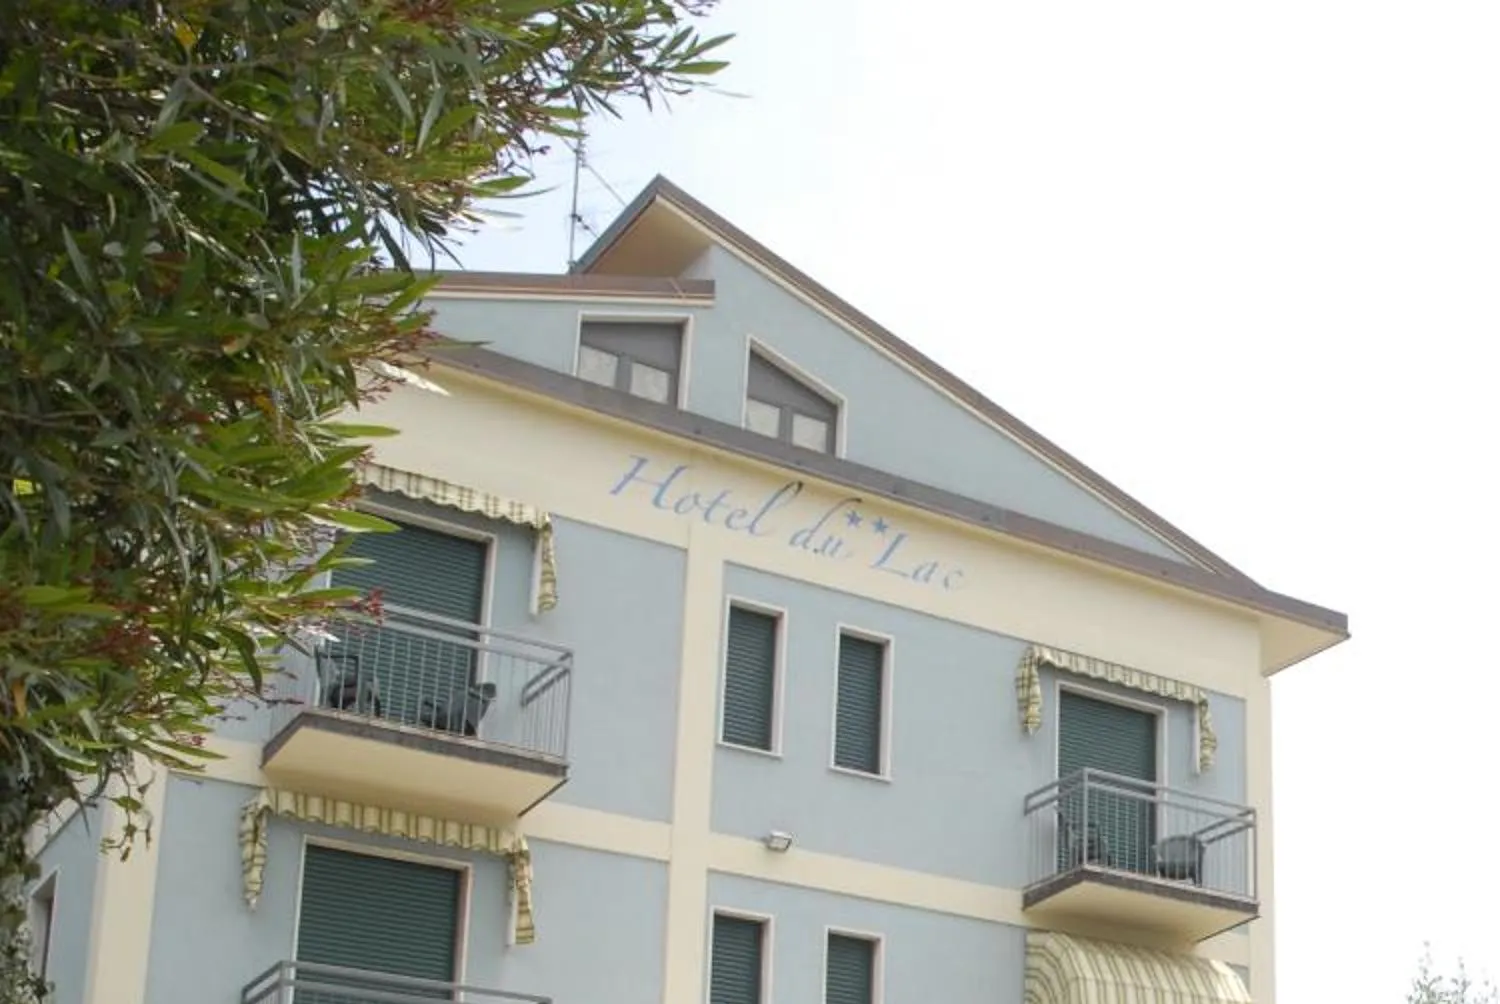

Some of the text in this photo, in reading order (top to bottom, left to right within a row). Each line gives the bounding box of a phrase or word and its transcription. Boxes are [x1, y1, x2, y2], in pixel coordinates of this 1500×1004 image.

[609, 454, 965, 591] Hotel du Lac
